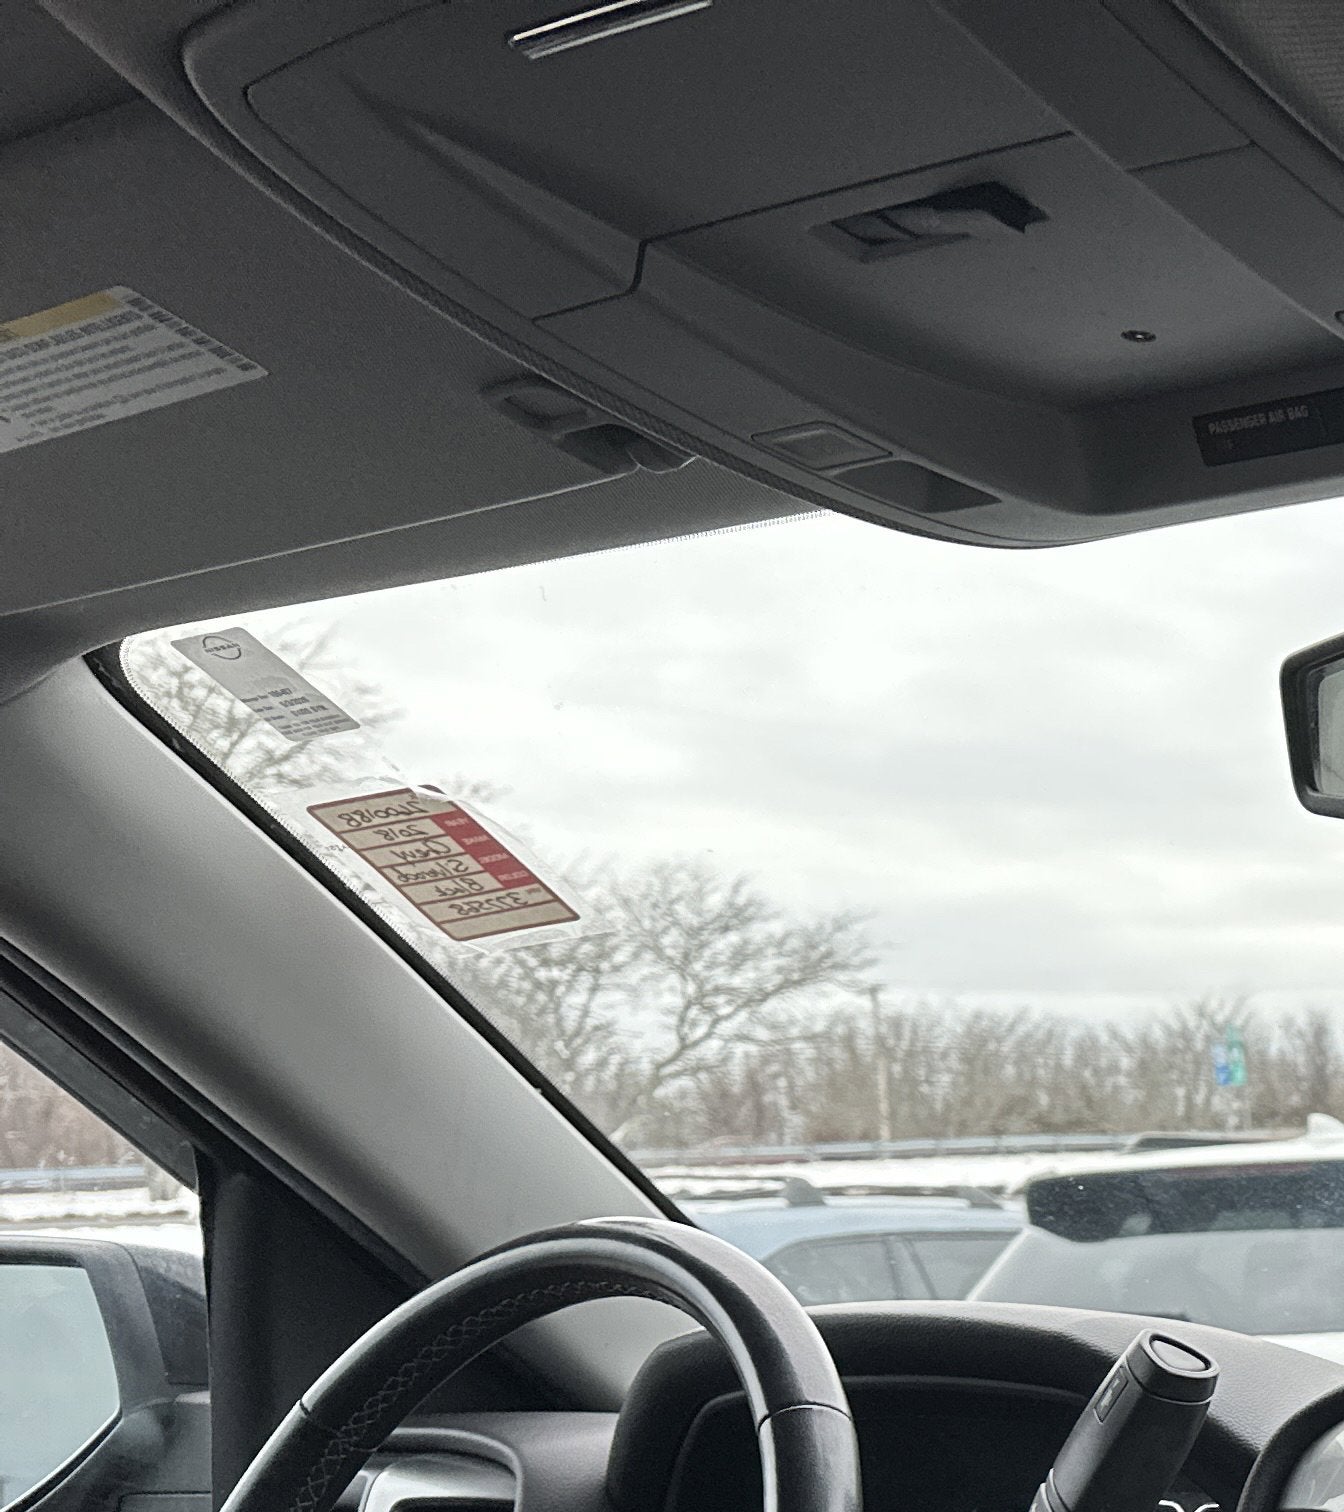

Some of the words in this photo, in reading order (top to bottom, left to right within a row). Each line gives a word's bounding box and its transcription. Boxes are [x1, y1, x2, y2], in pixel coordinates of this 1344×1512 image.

[1208, 413, 1267, 435] PASSENGER
[1268, 409, 1286, 425] AIR
[1287, 405, 1309, 421] BAG
